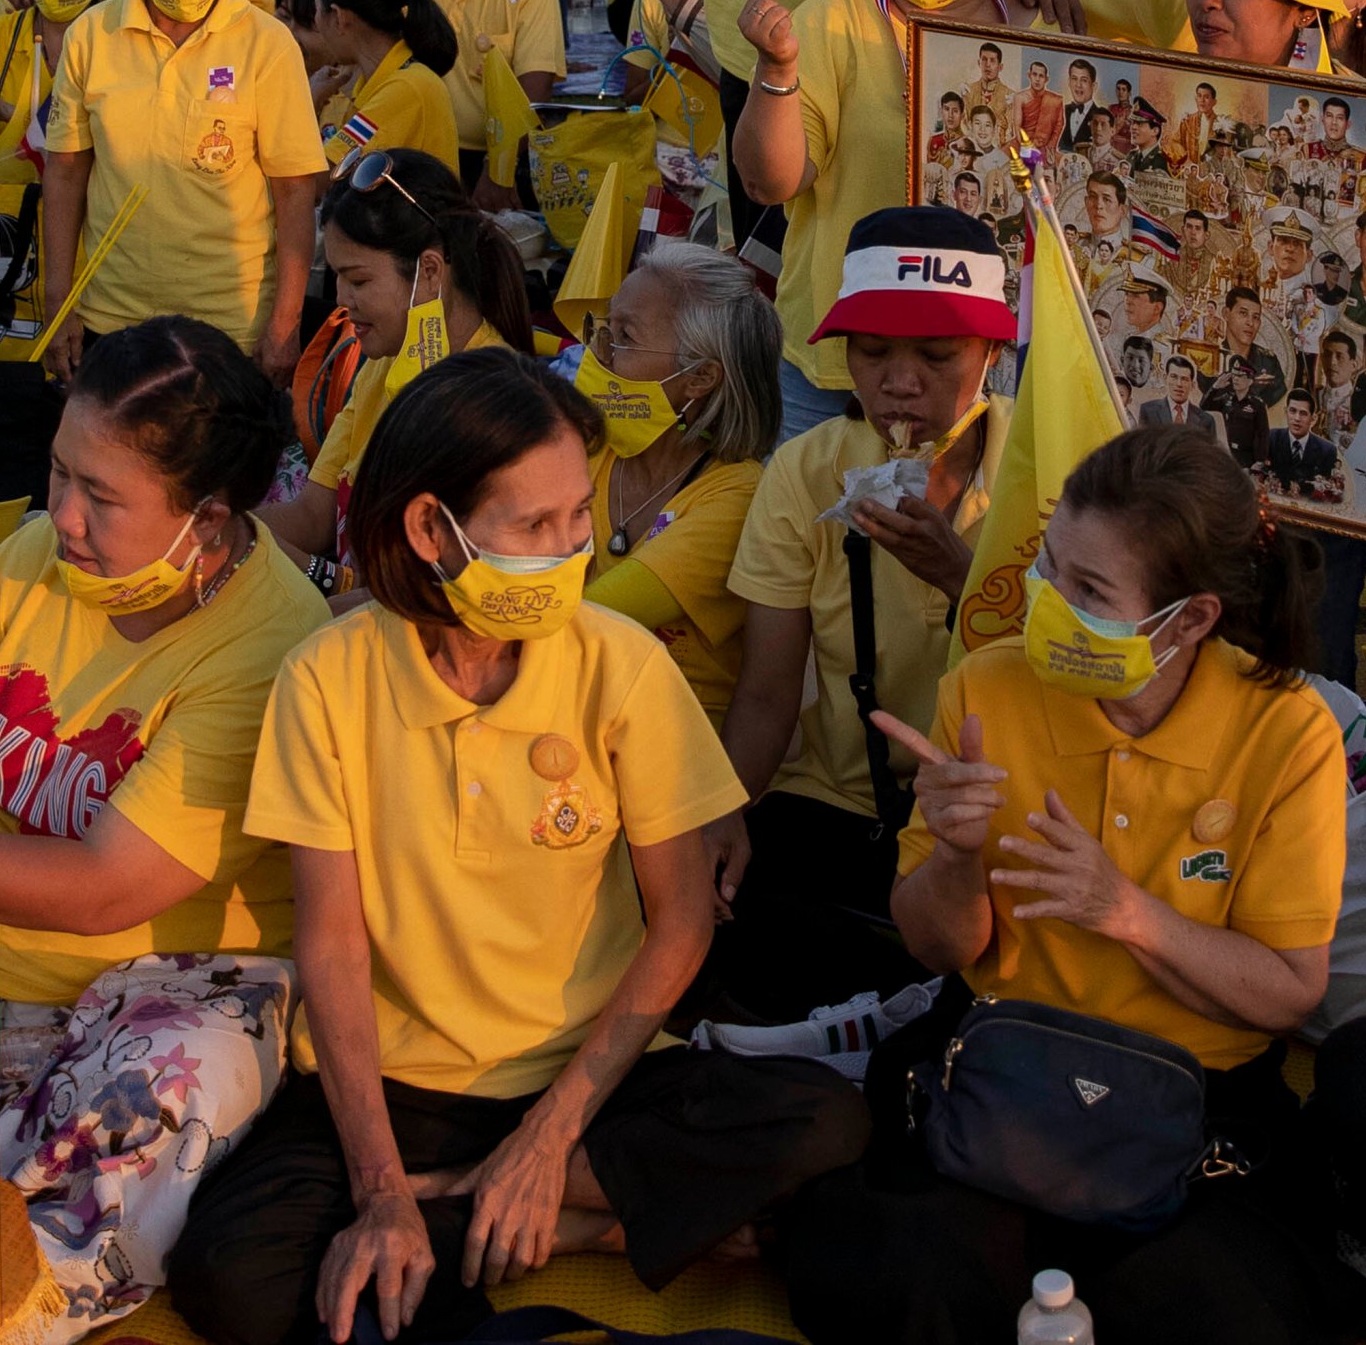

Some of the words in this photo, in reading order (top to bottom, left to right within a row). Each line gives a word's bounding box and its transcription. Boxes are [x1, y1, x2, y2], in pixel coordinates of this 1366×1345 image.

[898, 255, 972, 288] FILA
[482, 591, 522, 606] LONG
[523, 593, 561, 611] LIVE
[496, 603, 532, 617] KING
